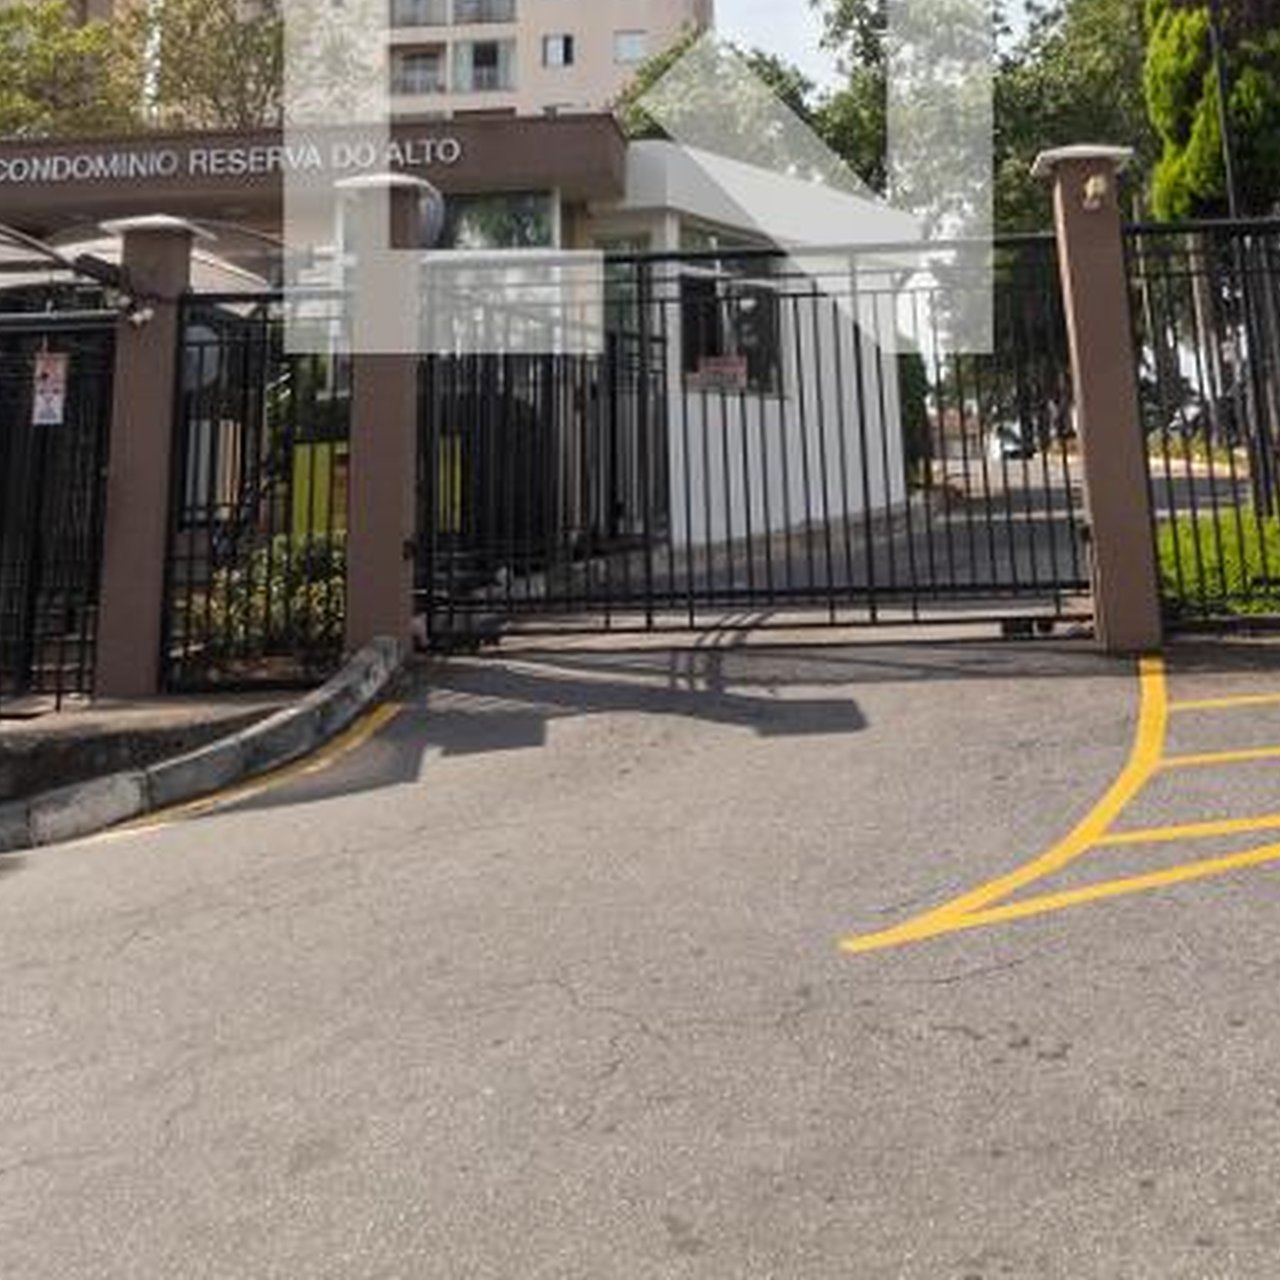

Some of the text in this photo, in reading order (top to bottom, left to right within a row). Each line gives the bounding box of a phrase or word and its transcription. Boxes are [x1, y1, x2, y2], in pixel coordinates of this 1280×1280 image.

[189, 144, 322, 174] RESERVA
[332, 141, 376, 169] DO
[387, 137, 461, 167] ALTO
